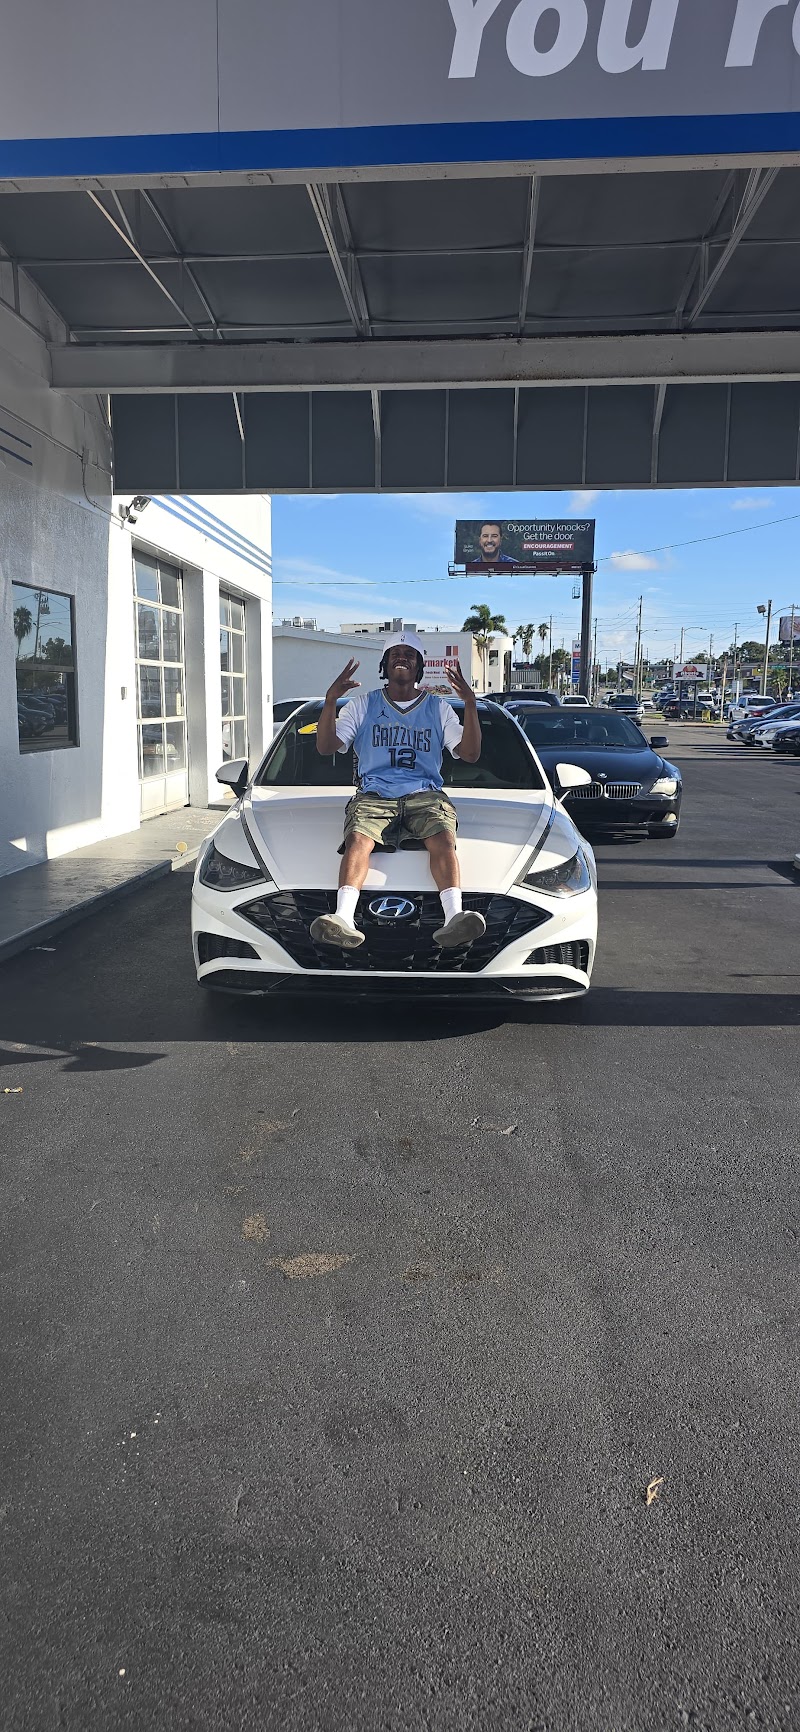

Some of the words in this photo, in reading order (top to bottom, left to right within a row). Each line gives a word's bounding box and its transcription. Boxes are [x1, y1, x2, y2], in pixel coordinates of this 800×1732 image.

[447, 0, 679, 78] You
[507, 523, 556, 533] Opportunity
[556, 522, 591, 532] knocks?
[523, 532, 538, 541] Get
[539, 532, 553, 540] the
[554, 532, 575, 540] door.
[424, 658, 457, 668] rmarket
[372, 724, 432, 752] GRIZZLIES
[388, 748, 416, 769] 12
